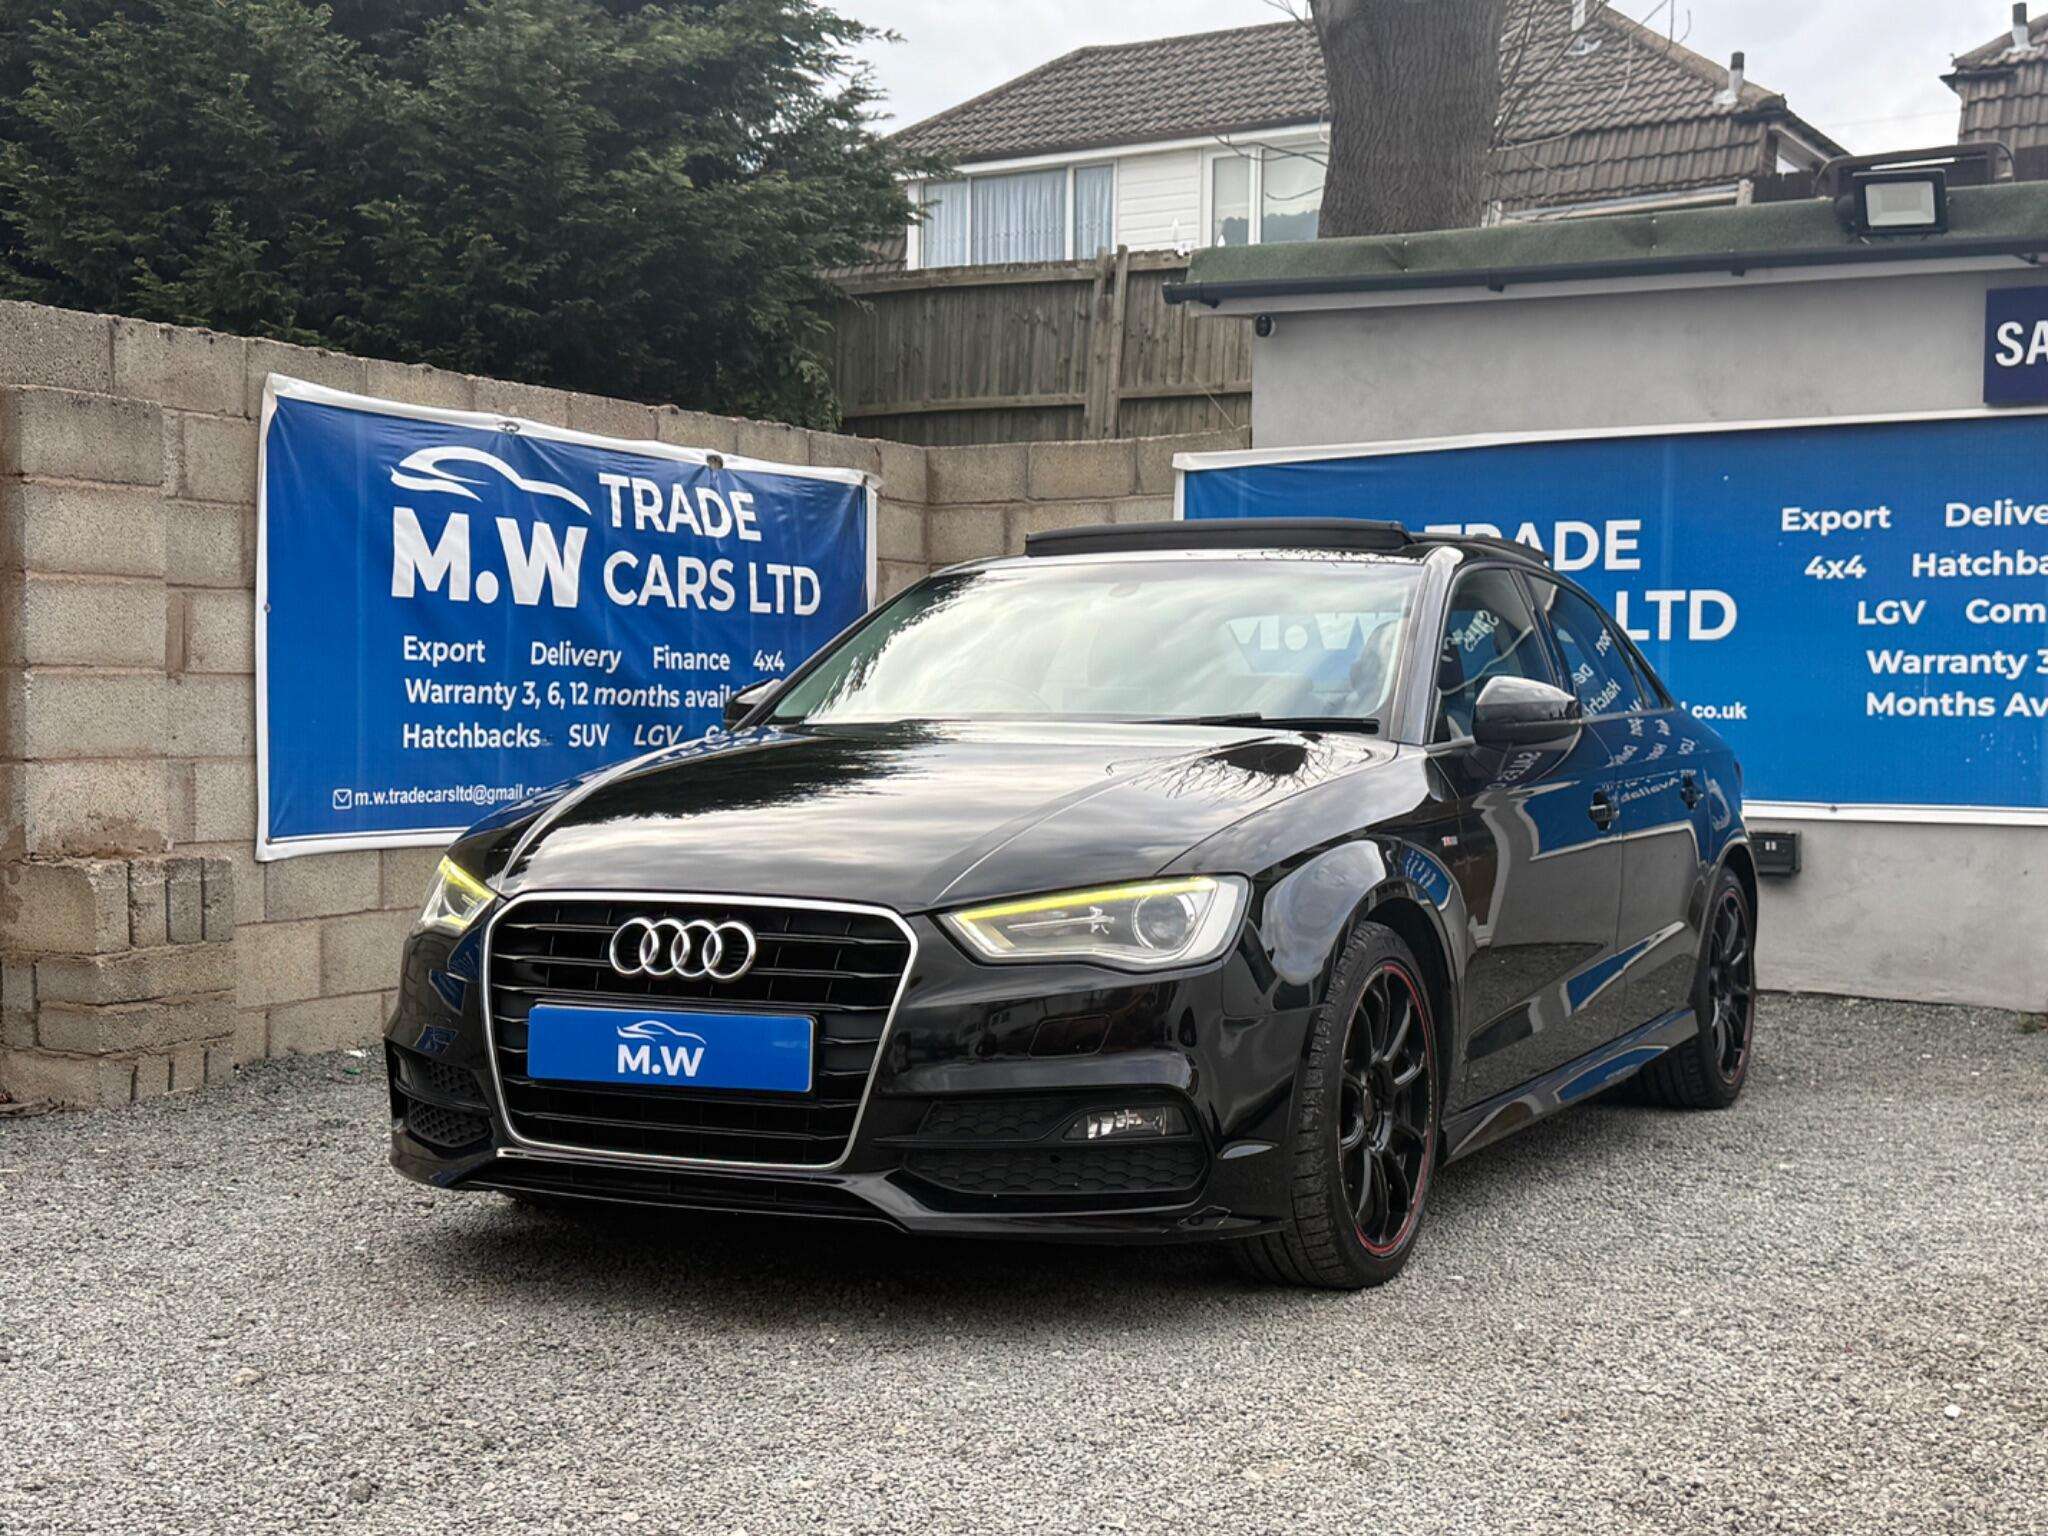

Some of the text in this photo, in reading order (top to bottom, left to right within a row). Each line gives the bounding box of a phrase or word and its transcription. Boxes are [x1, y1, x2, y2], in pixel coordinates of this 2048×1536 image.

[599, 473, 762, 542] TRADE
[1782, 499, 2048, 536] Export Delive
[391, 506, 589, 609] M.W
[1424, 518, 1642, 570] ADE
[1804, 549, 2048, 580] 4x4 Hatchba
[603, 550, 822, 616] CARS LTD
[1615, 589, 1738, 642] LTD
[1857, 599, 2046, 625] LGV Com
[403, 635, 785, 674] Export Delivery Finance 4x4
[1866, 650, 2028, 680] Warranty
[405, 678, 517, 711] Warranty
[521, 680, 541, 709] 3,
[547, 680, 565, 709] 6,
[569, 681, 589, 705] 12
[594, 682, 680, 708] months
[1866, 691, 1996, 717] Months
[402, 722, 541, 748] Hatchbacks
[568, 724, 610, 747] SUV
[634, 724, 682, 747] LGV
[617, 1044, 705, 1077] M.W
